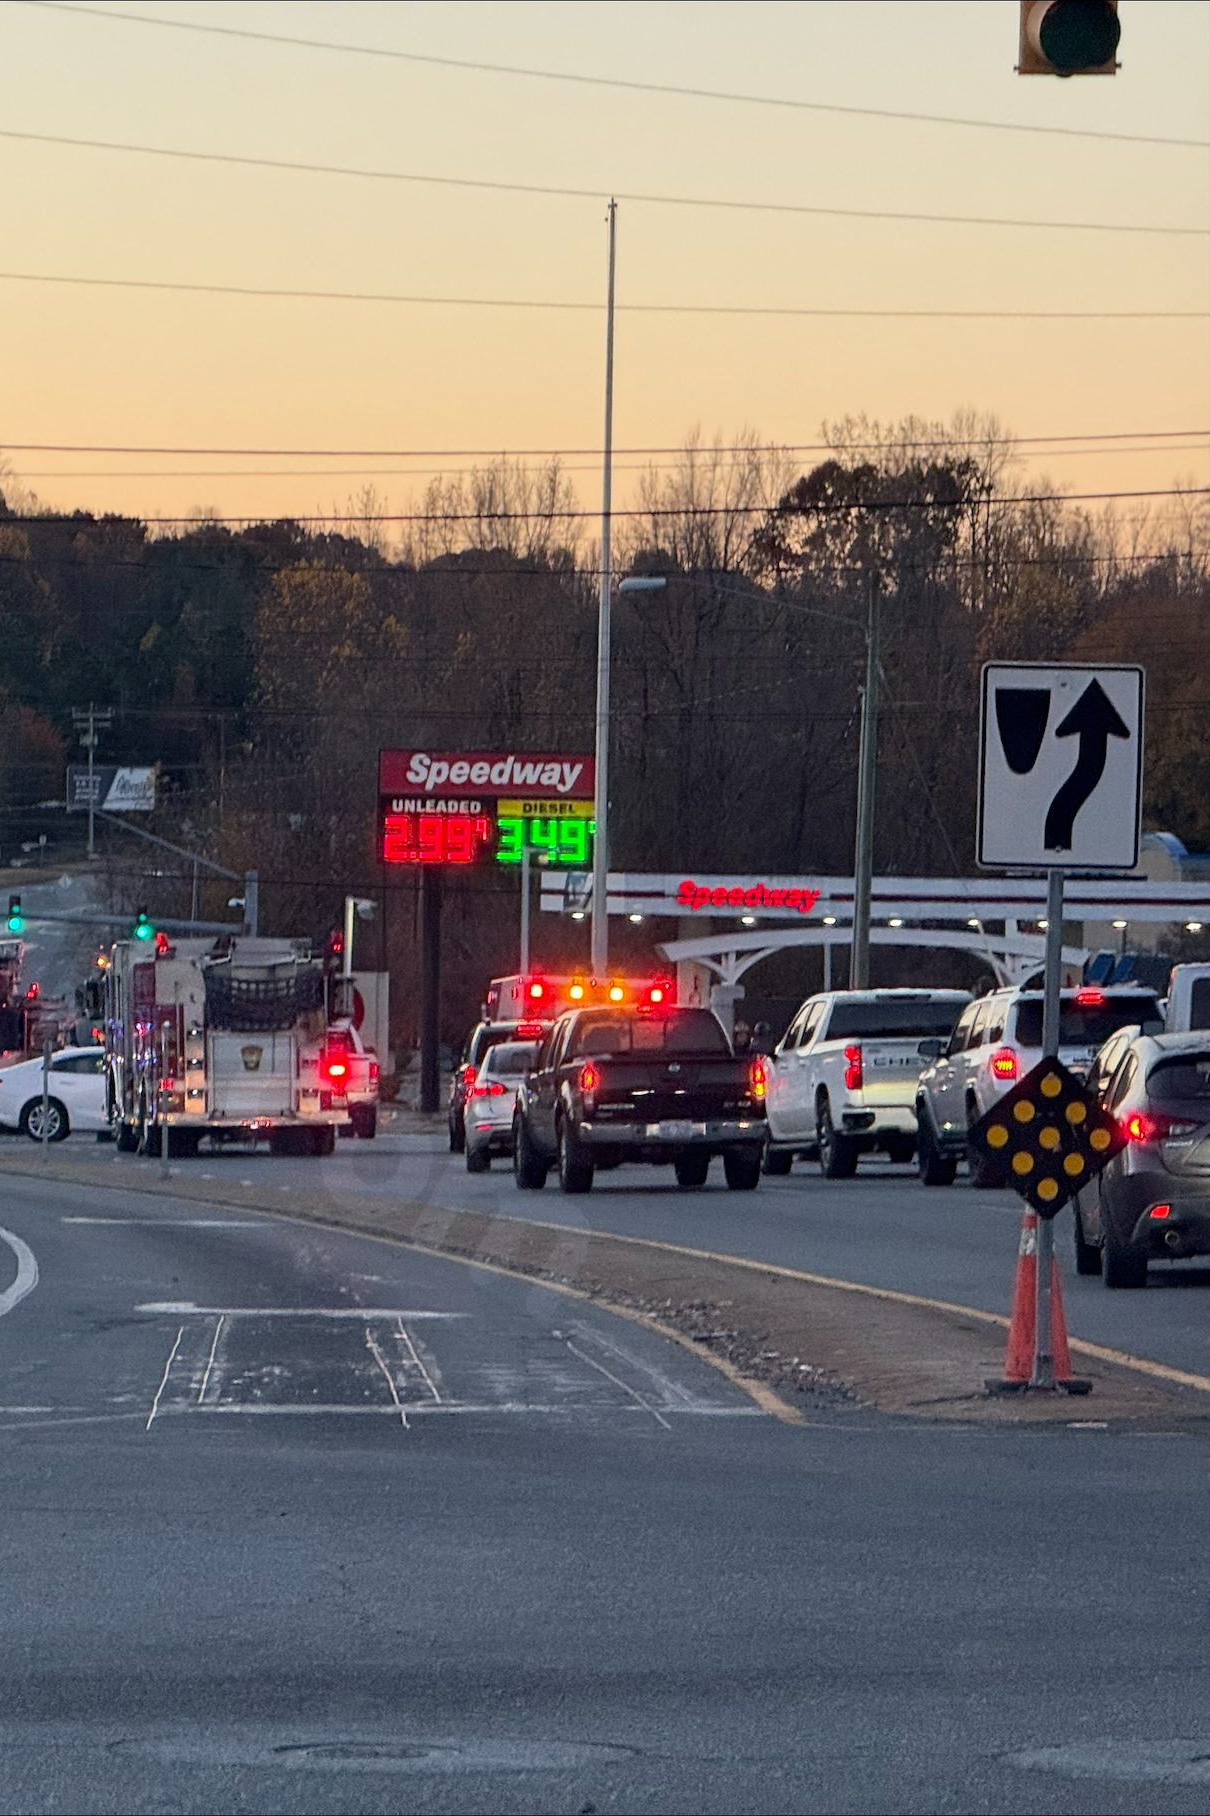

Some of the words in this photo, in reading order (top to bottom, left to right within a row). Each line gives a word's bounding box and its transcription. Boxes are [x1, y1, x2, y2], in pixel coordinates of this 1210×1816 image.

[406, 753, 583, 793] Speedway
[392, 799, 481, 813] UNLEADED
[522, 803, 576, 814] DIESEL
[676, 879, 820, 913] Speedway
[873, 1057, 932, 1067] CHEV
